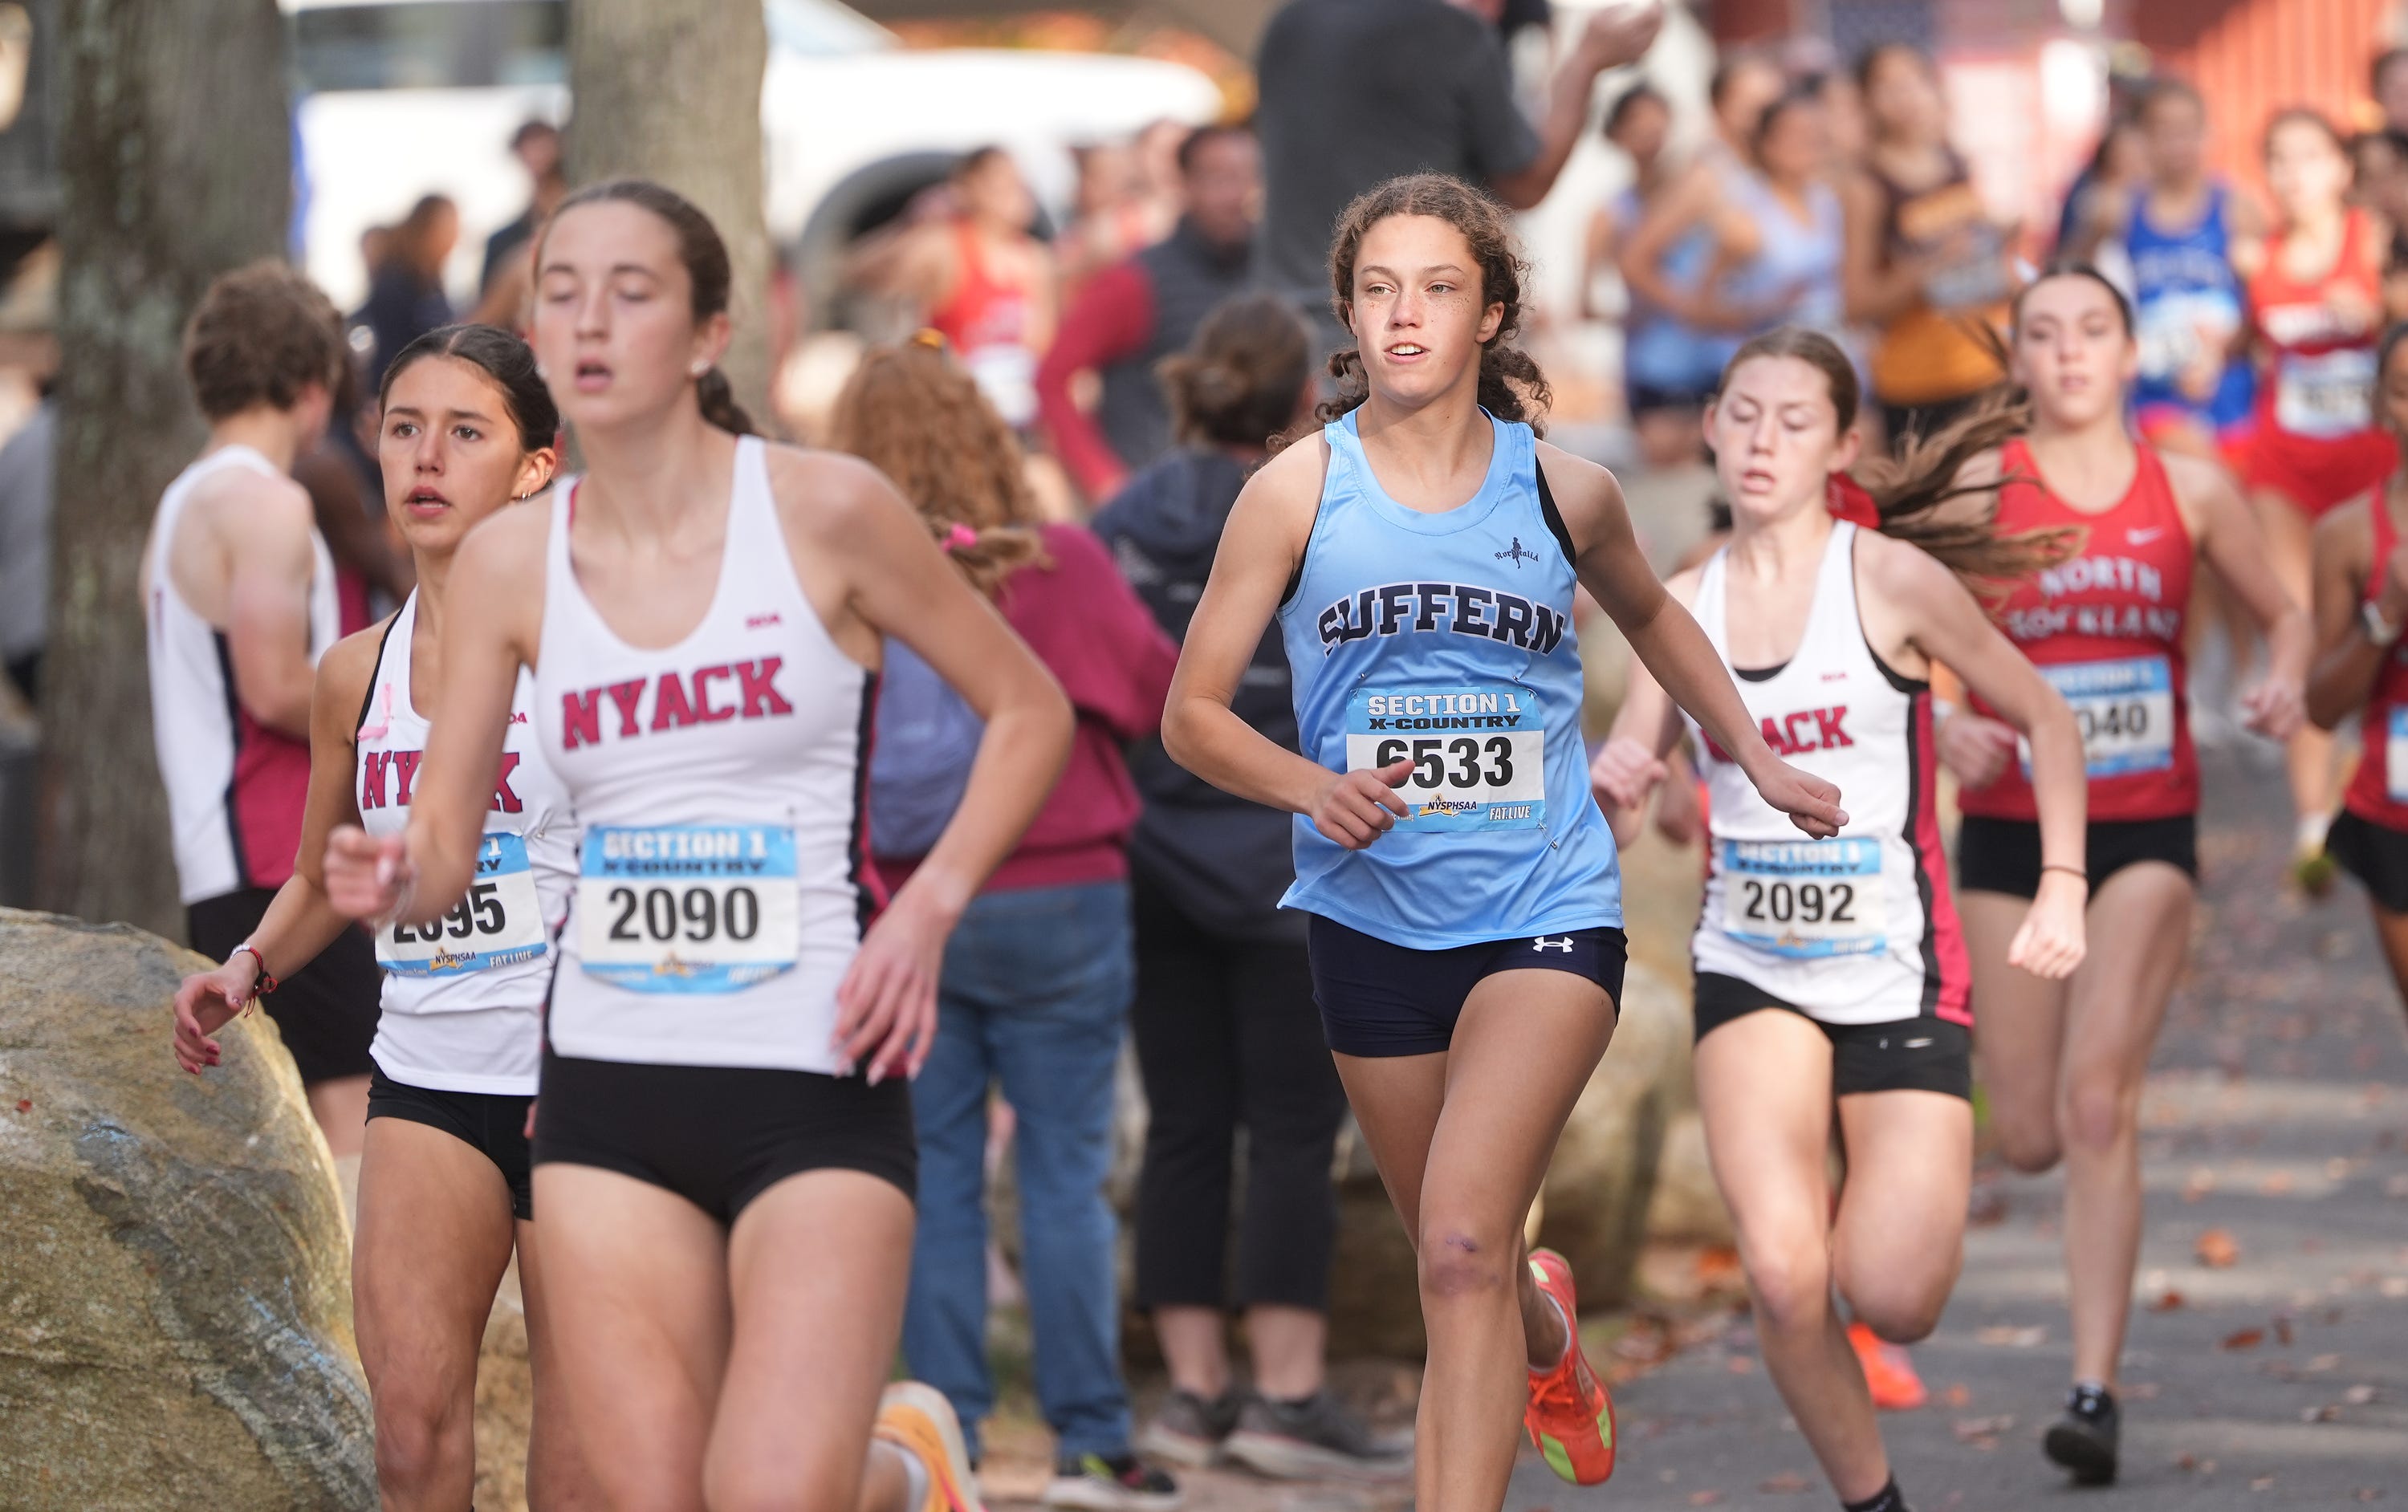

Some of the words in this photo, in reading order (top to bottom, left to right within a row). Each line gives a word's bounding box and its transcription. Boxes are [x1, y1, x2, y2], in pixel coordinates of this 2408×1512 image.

[2039, 555, 2162, 602] NORTH
[1318, 581, 1564, 657] SUFFERN
[561, 656, 794, 751] NYACK
[1368, 693, 1501, 717] SECTION
[1506, 693, 1521, 713] 1
[1369, 715, 1521, 730] X-COUNTRY
[2074, 703, 2148, 741] 040
[1701, 705, 1853, 763] ACK
[362, 750, 523, 812] NYK
[1377, 737, 1514, 788] 6533
[1427, 801, 1477, 811] NYSPHSAA
[1489, 806, 1531, 820] FAT.LIVE
[604, 831, 740, 860] SECTION
[750, 831, 768, 860] 1
[608, 887, 759, 942] 2090
[1744, 880, 1856, 922] 2092
